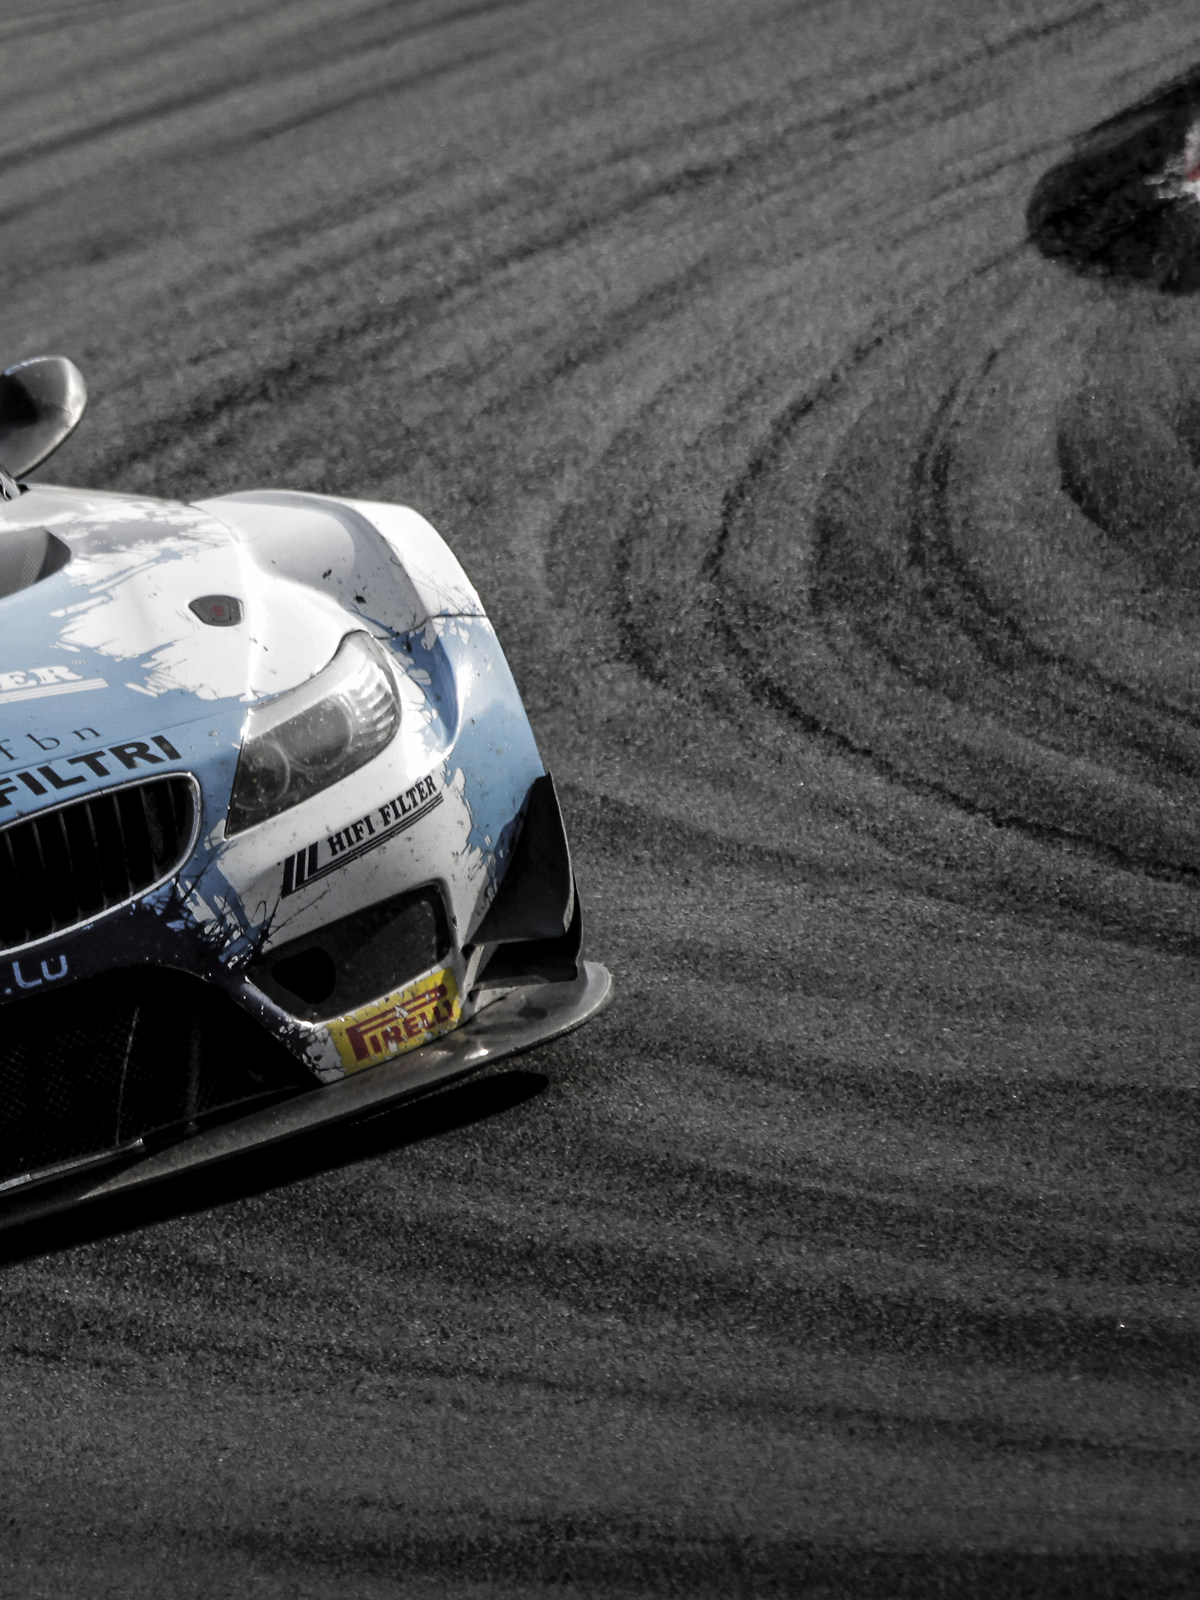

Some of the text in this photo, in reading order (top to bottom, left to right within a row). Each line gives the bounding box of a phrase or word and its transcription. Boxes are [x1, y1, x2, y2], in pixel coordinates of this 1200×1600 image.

[328, 773, 437, 857] HIFI FILTER
[345, 985, 453, 1062] PIRELLI
